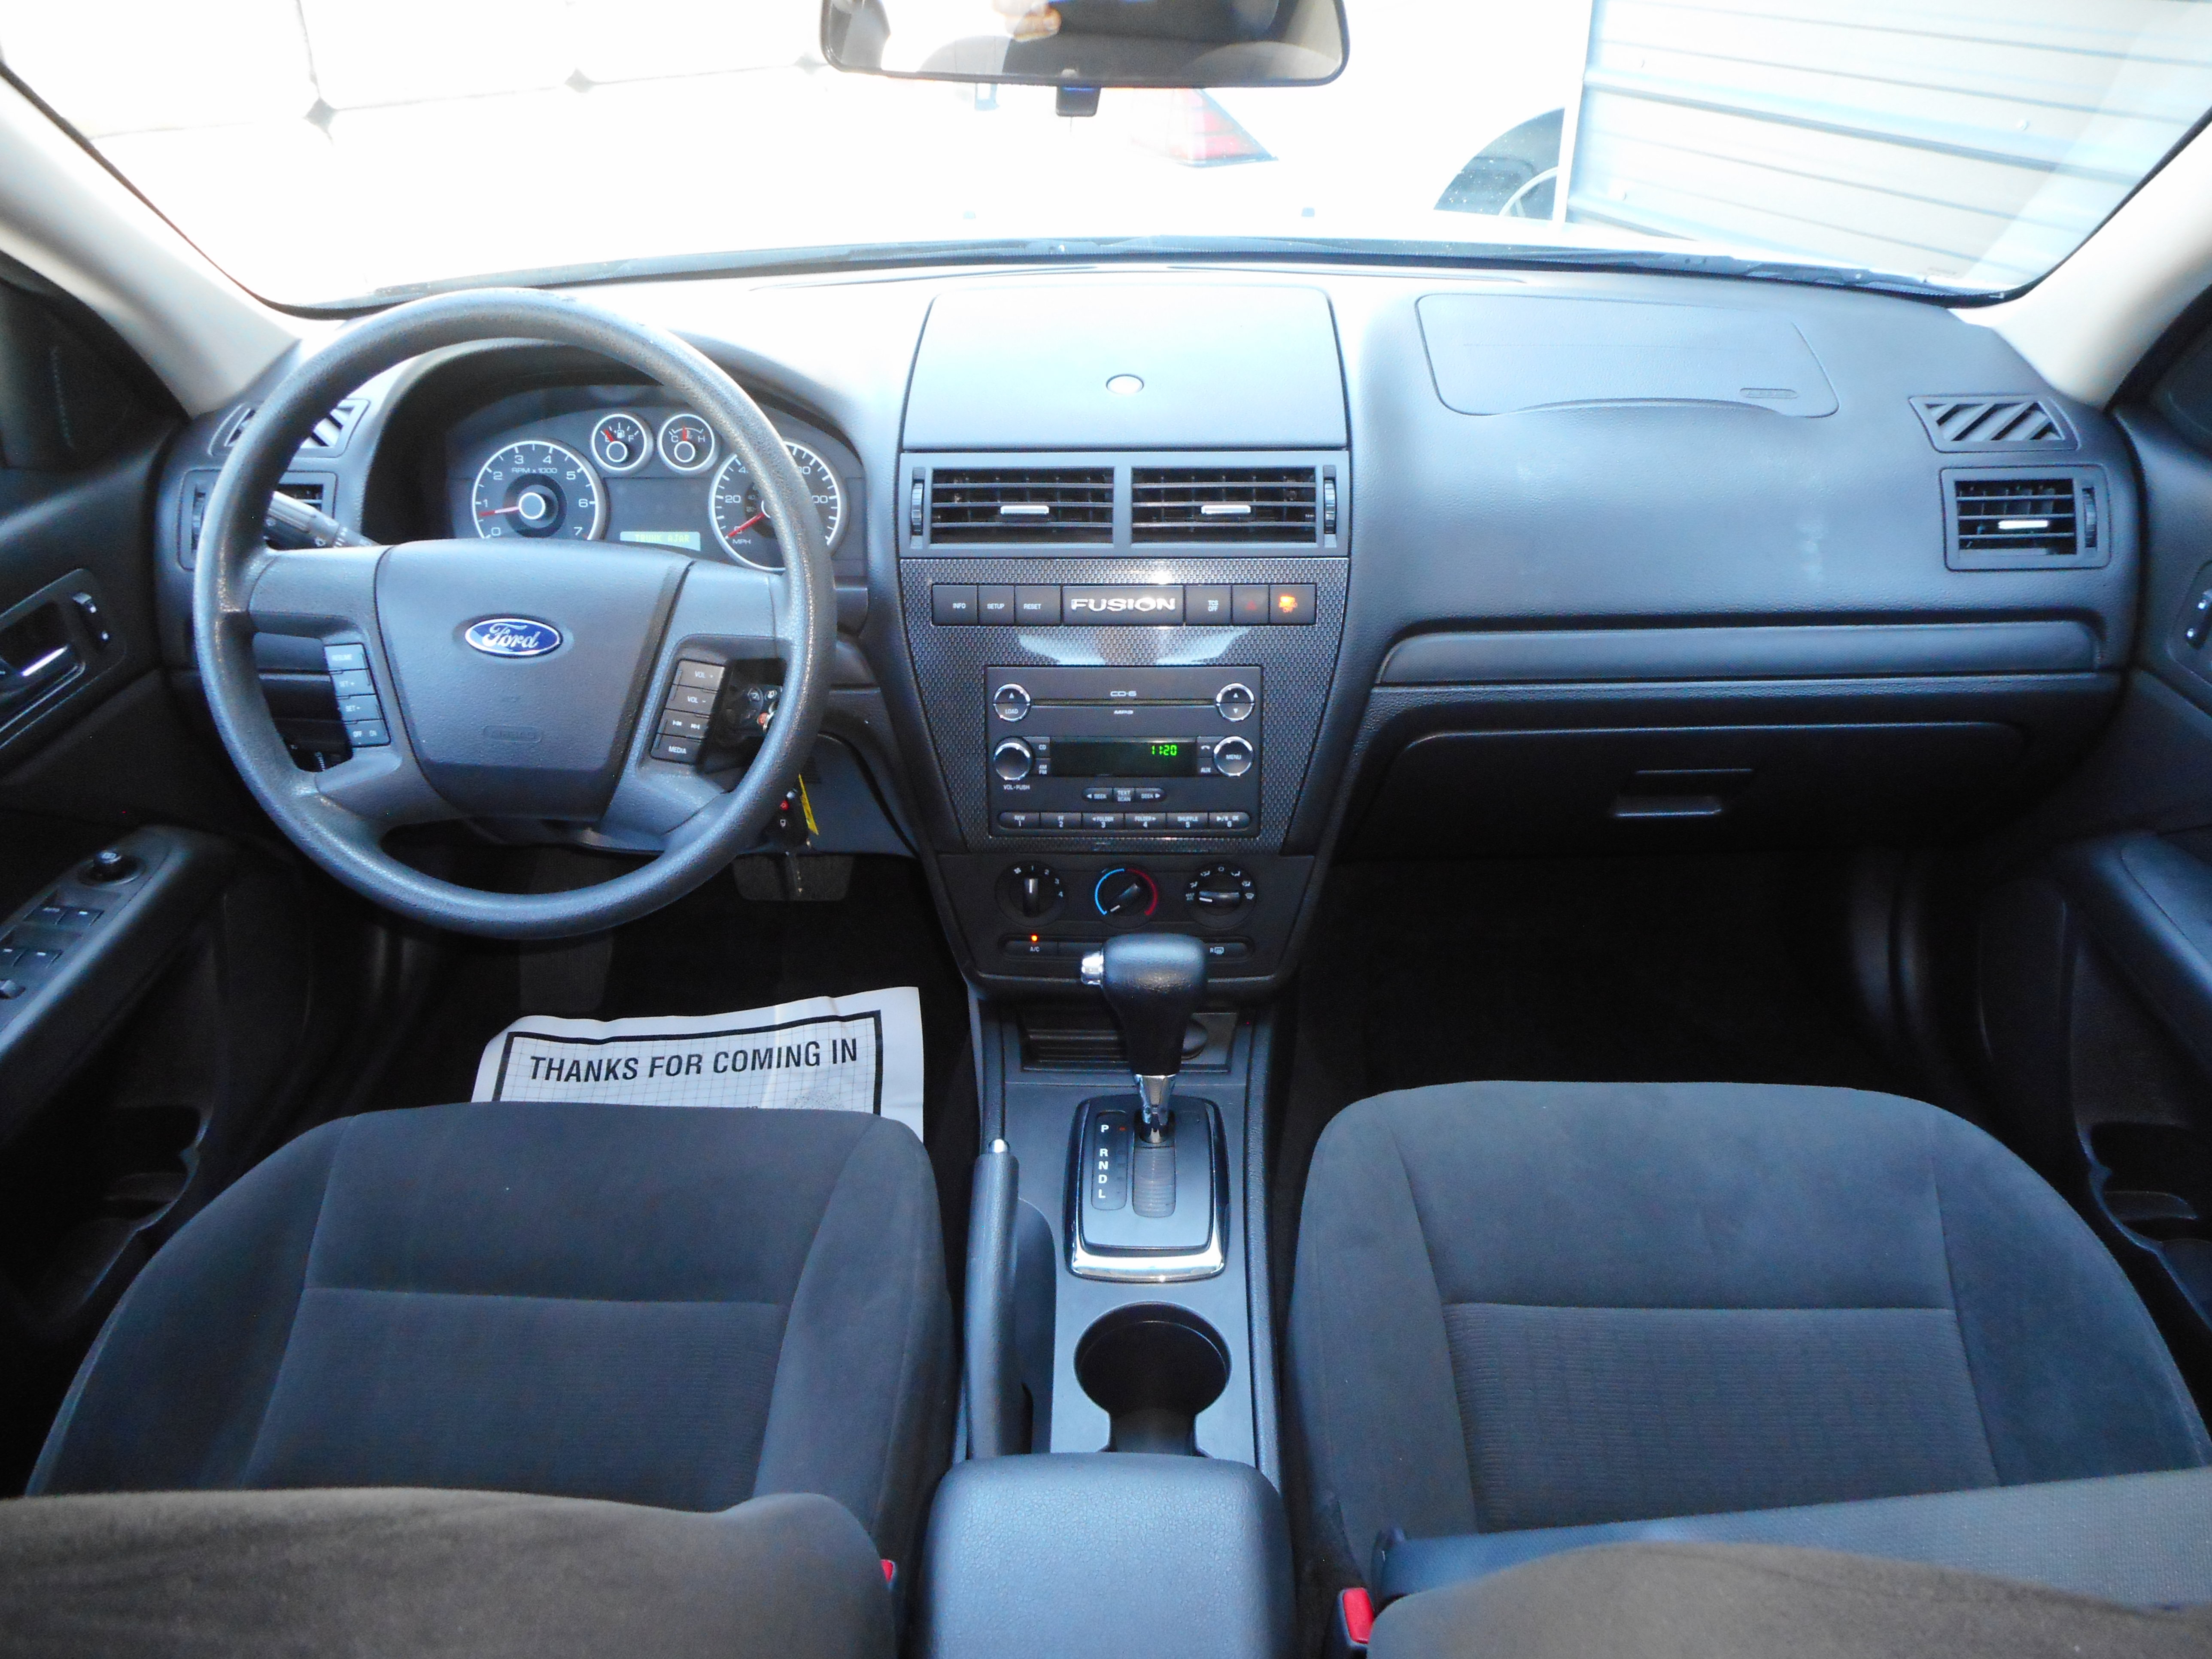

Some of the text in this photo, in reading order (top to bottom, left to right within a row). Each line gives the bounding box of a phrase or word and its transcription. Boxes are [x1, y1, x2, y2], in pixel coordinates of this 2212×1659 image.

[514, 455, 524, 464] 3
[543, 455, 552, 464] 4
[493, 471, 503, 480] 2
[566, 471, 576, 480] 5
[483, 499, 488, 507] 1
[578, 498, 588, 507] 6
[725, 495, 741, 503] 20
[811, 495, 828, 504] 00
[491, 527, 501, 536] 0
[574, 527, 583, 536] 7
[635, 534, 690, 542] TRUNK AJAR
[1071, 597, 1175, 611] FUSION
[482, 623, 541, 648] Ford
[668, 746, 687, 754] MEDIA
[1152, 745, 1177, 756] 11:20
[530, 1038, 857, 1082] THANKS FOR COMING IN
[1101, 1124, 1109, 1133] P
[1100, 1148, 1108, 1157] R
[1098, 1161, 1108, 1170] N
[1098, 1175, 1108, 1184] D
[1098, 1189, 1106, 1198] L
